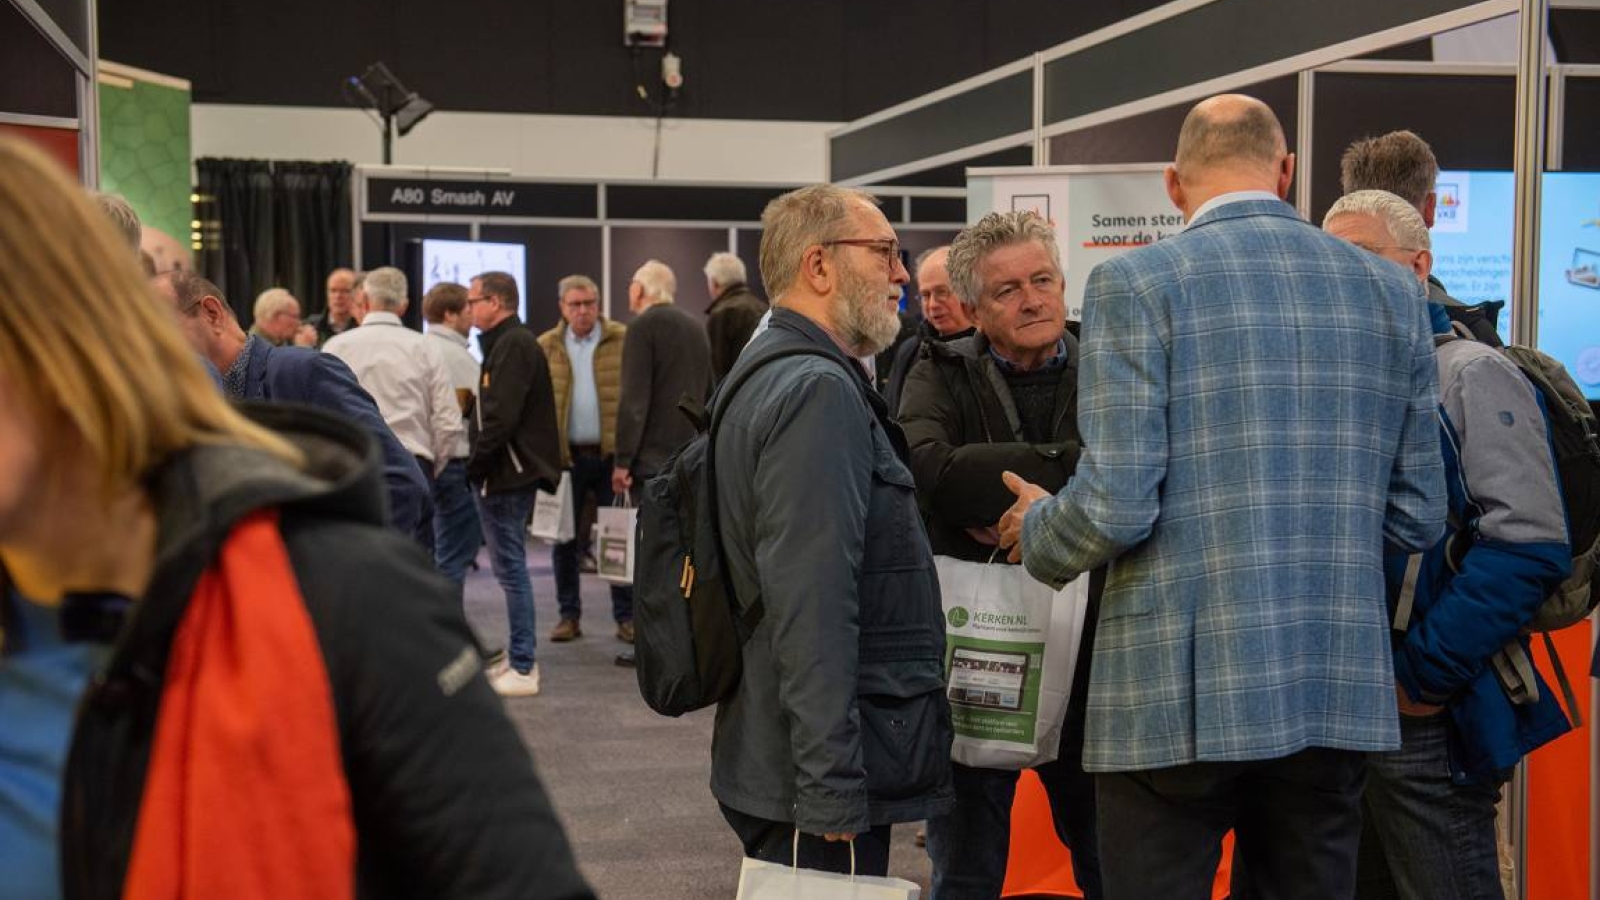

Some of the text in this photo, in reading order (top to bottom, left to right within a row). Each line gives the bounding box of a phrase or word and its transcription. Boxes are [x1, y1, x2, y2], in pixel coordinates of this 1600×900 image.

[391, 187, 516, 206] A80 Smash AV
[1092, 212, 1185, 228] Samen ster
[1092, 234, 1128, 246] voor
[1133, 230, 1153, 246] de
[973, 611, 1028, 626] KERKEN.NL
